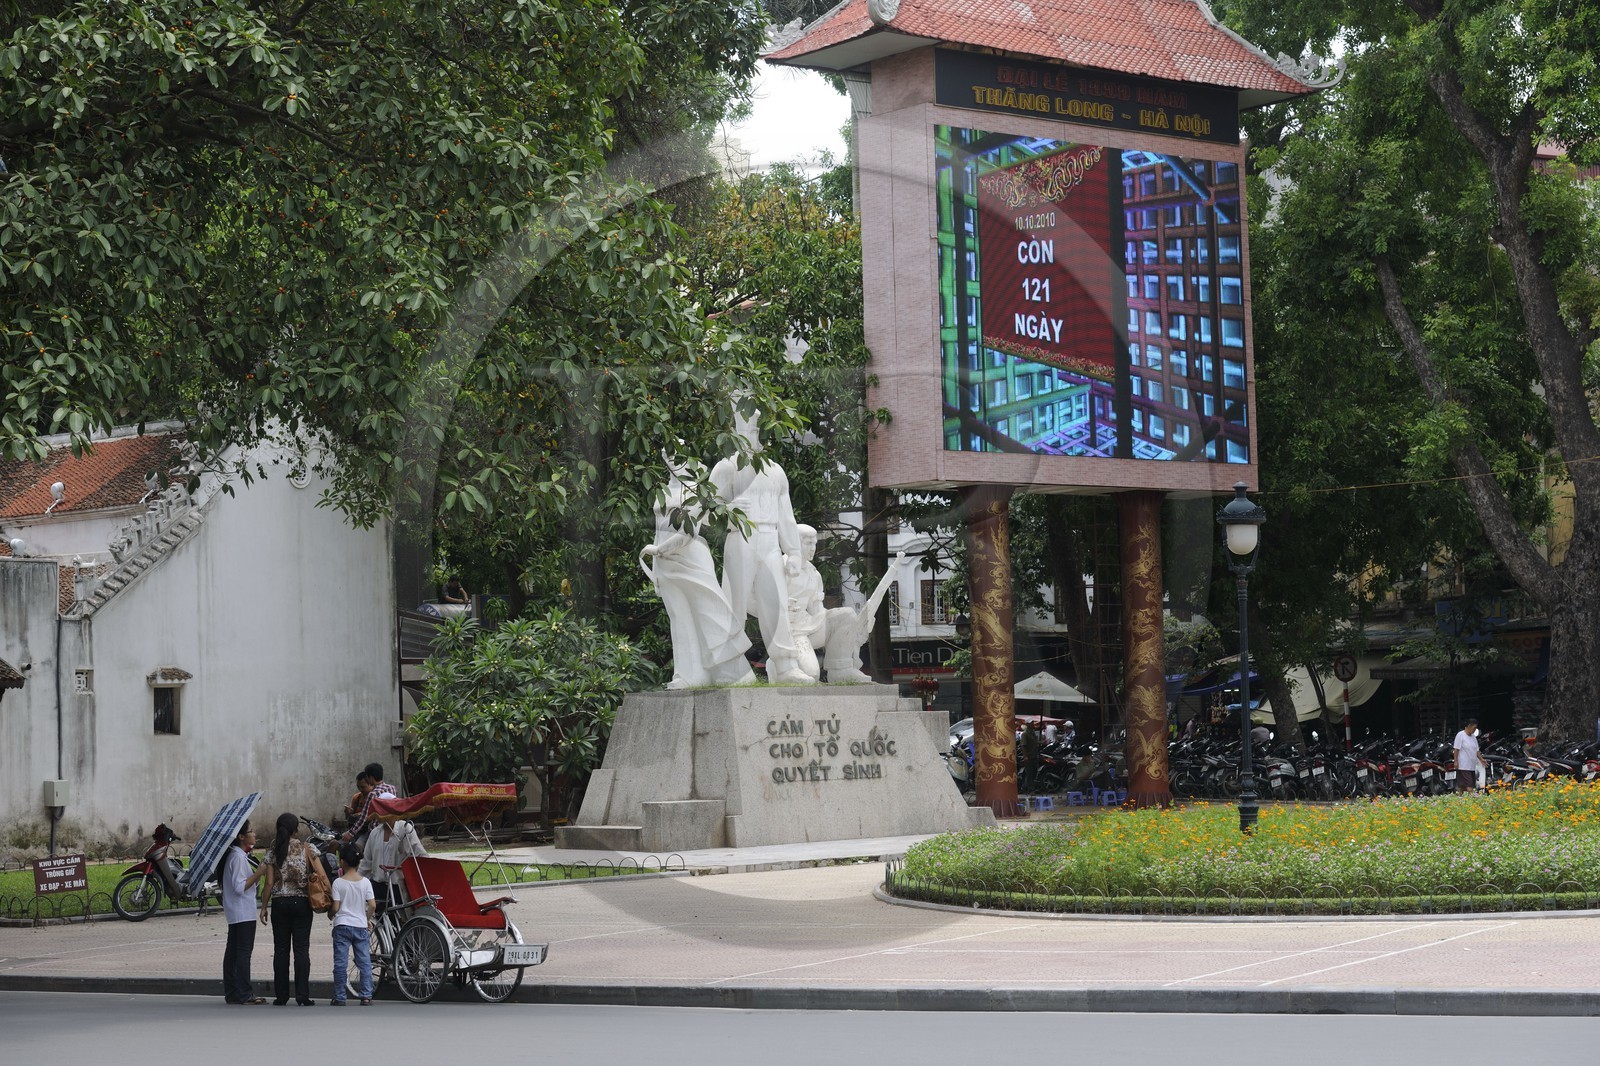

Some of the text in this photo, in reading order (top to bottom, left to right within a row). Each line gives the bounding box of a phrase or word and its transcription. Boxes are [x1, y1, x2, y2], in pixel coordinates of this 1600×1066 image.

[972, 85, 1050, 113] THĂNG
[1055, 97, 1114, 122] LONG
[1174, 113, 1212, 136] NỘI
[1014, 211, 1056, 232] 10.10.2010
[1018, 234, 1054, 265] CÒN
[1022, 277, 1050, 304] 121
[1014, 310, 1064, 345] NGÀY
[893, 647, 933, 664] Tien
[769, 743, 804, 758] CHO
[850, 733, 897, 757] QUỐC
[771, 759, 831, 783] QUYẾT
